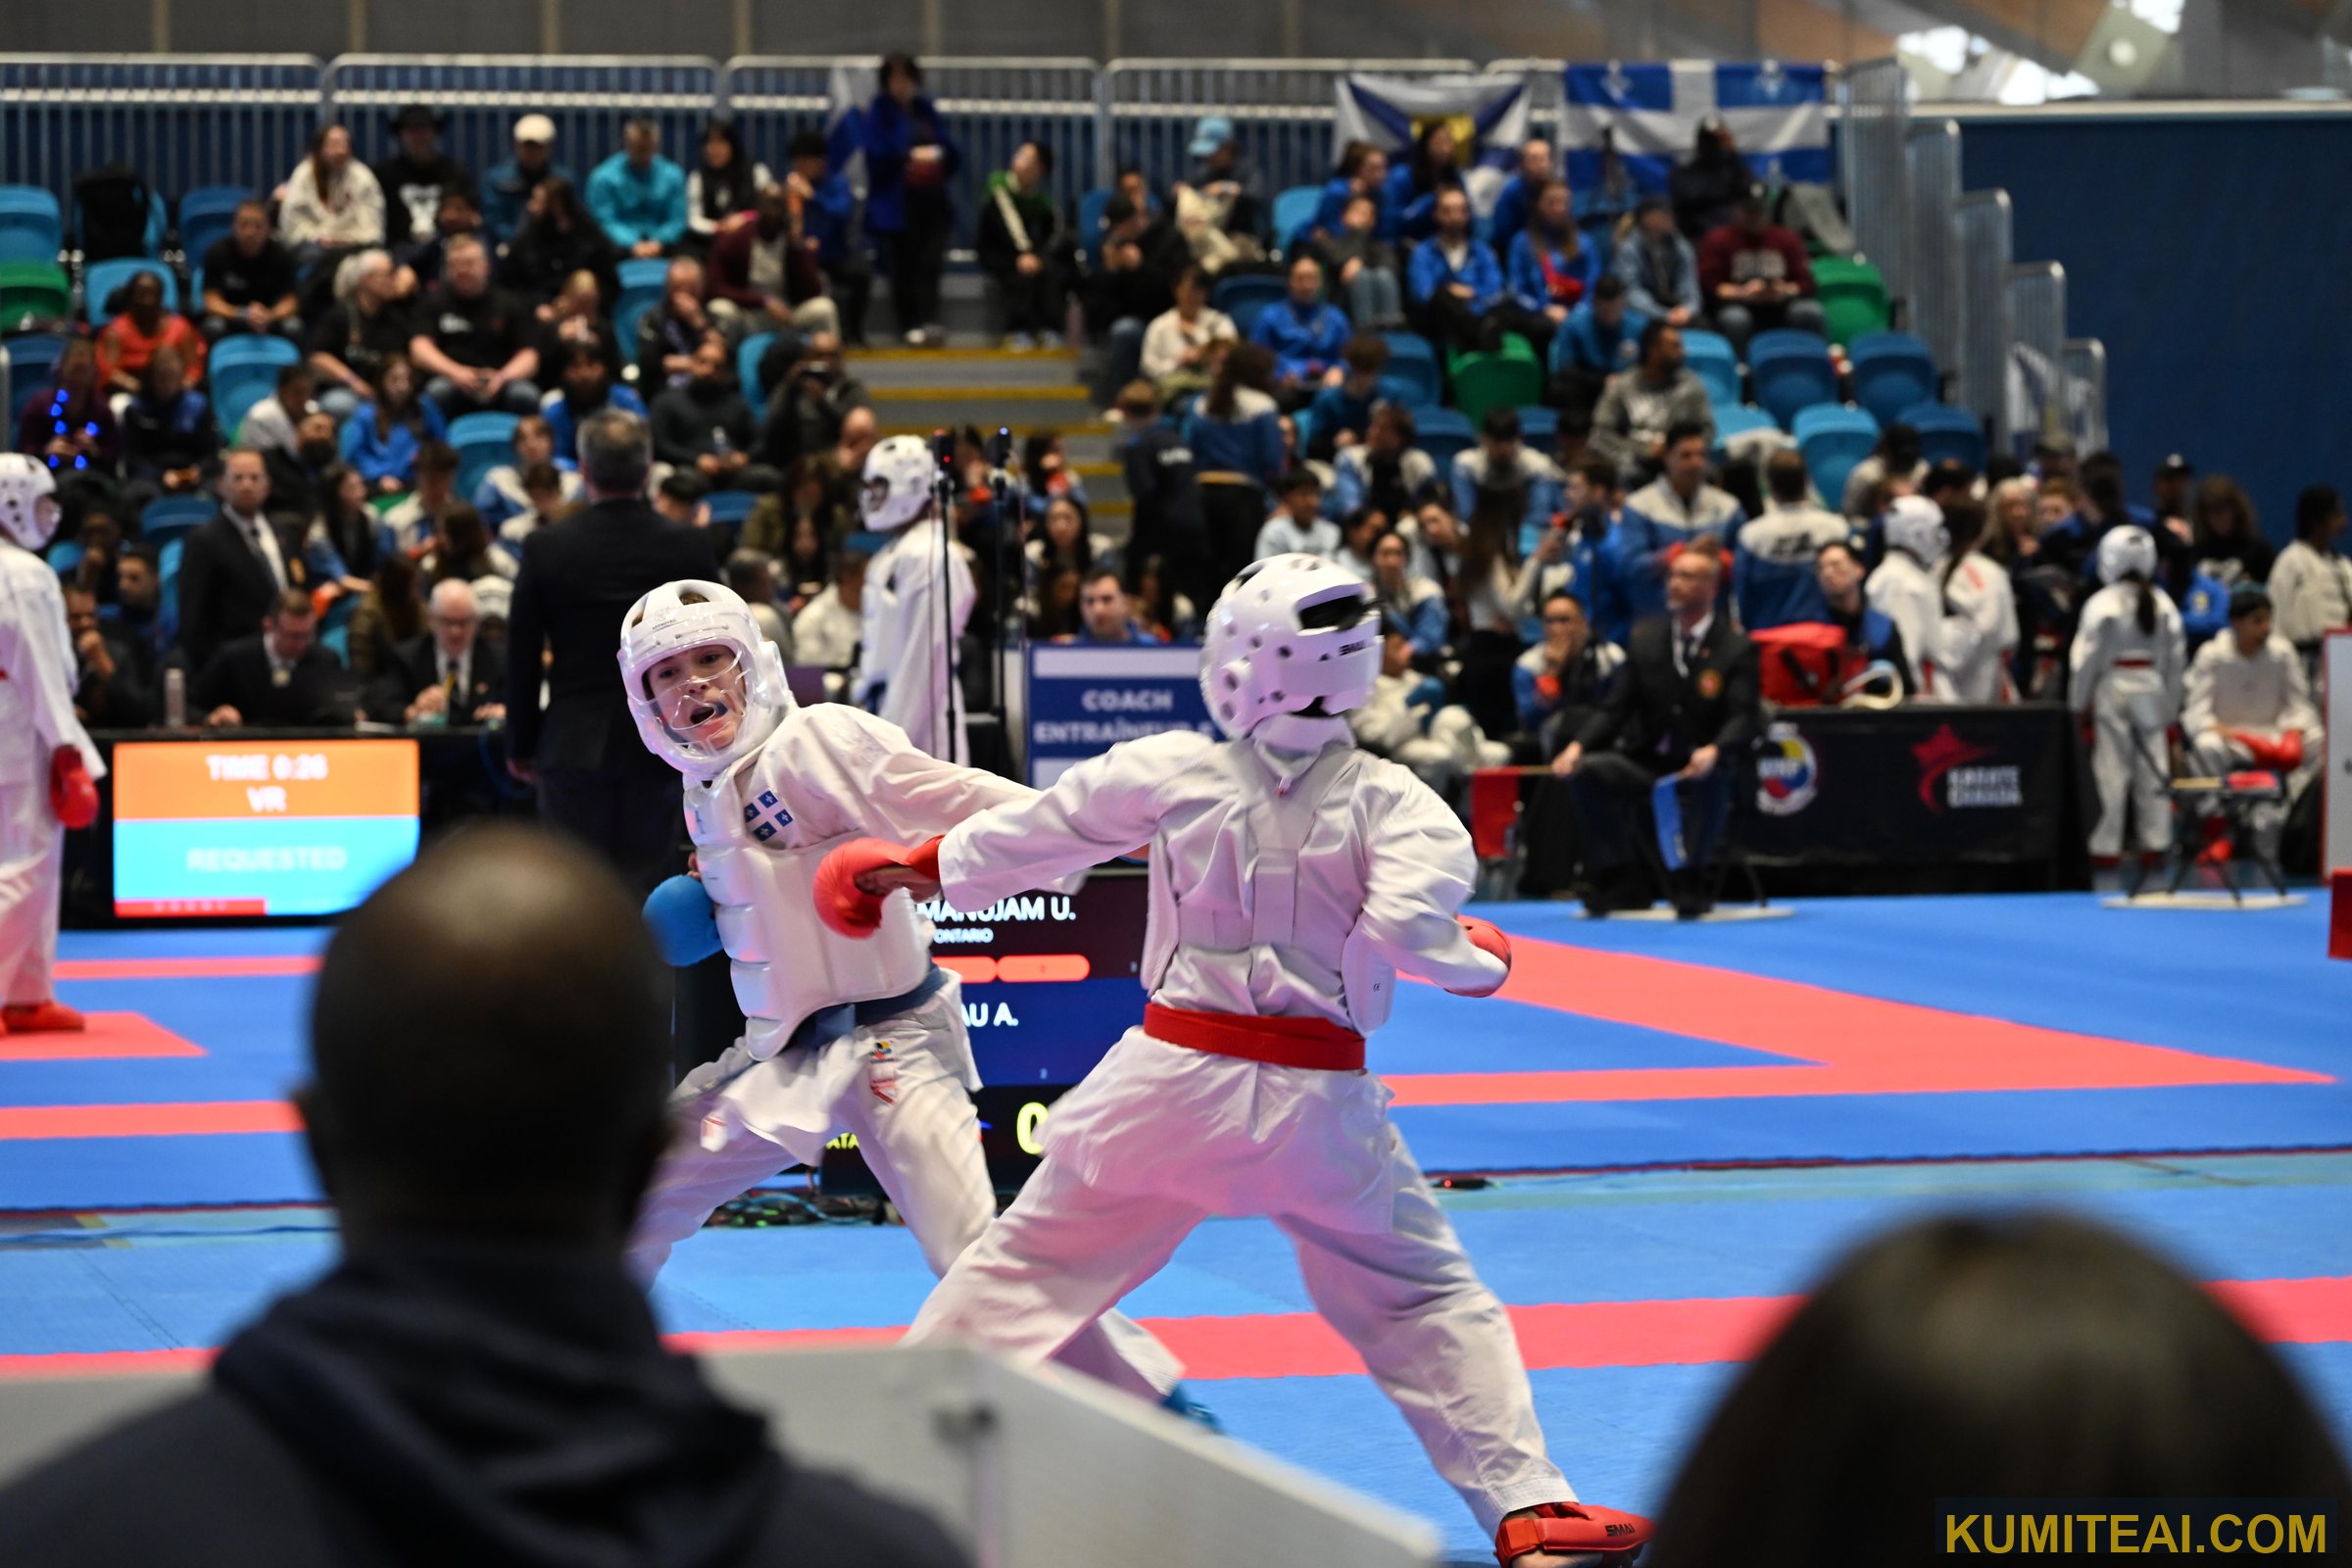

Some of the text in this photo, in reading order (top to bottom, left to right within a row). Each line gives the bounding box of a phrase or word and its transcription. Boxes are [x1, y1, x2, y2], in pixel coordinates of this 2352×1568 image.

[1081, 689, 1174, 711] COACH
[206, 754, 270, 781] TIME
[247, 786, 287, 812] VR
[186, 846, 348, 872] REQUESTED
[1050, 896, 1077, 921] U.
[933, 927, 995, 944] ONTARIO
[993, 1003, 1019, 1027] A.
